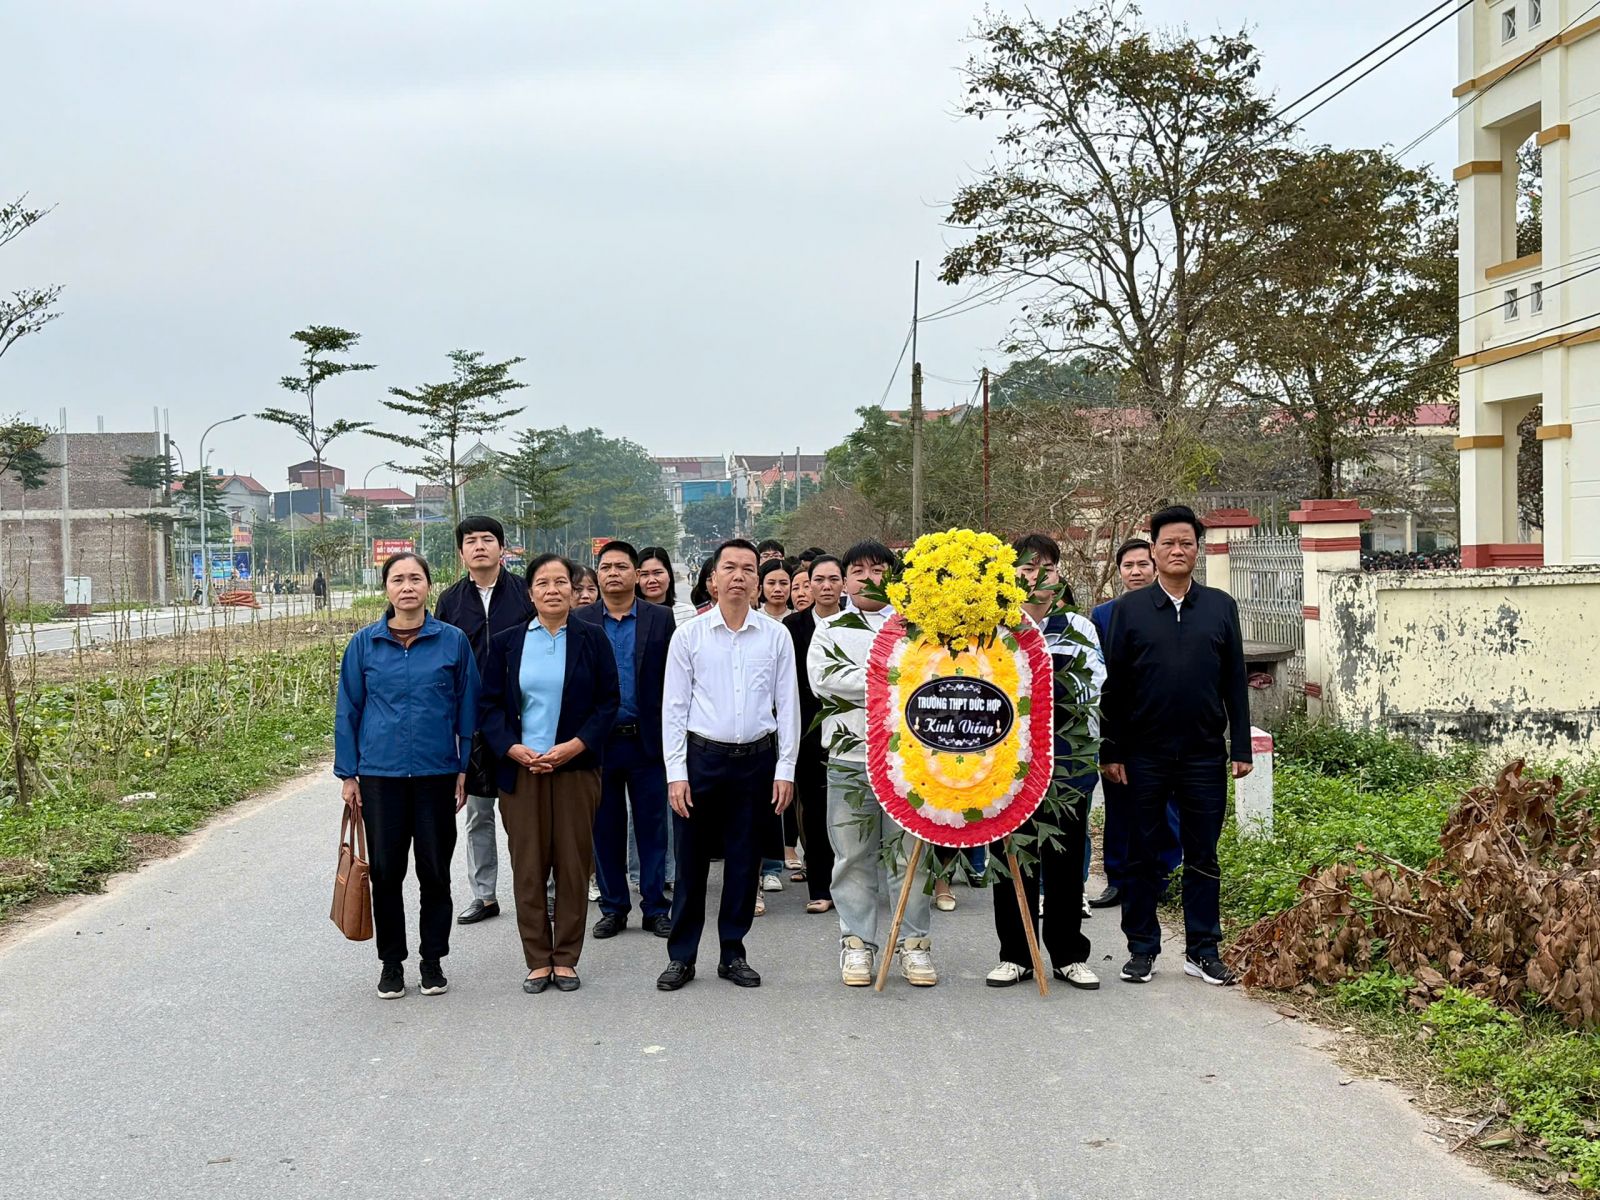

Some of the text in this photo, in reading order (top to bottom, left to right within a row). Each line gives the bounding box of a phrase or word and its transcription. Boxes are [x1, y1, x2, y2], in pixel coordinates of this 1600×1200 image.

[917, 694, 947, 710] TRƯỜNG
[948, 697, 968, 711] THPT
[986, 698, 1002, 714] HỢP
[958, 719, 994, 738] Viếng
